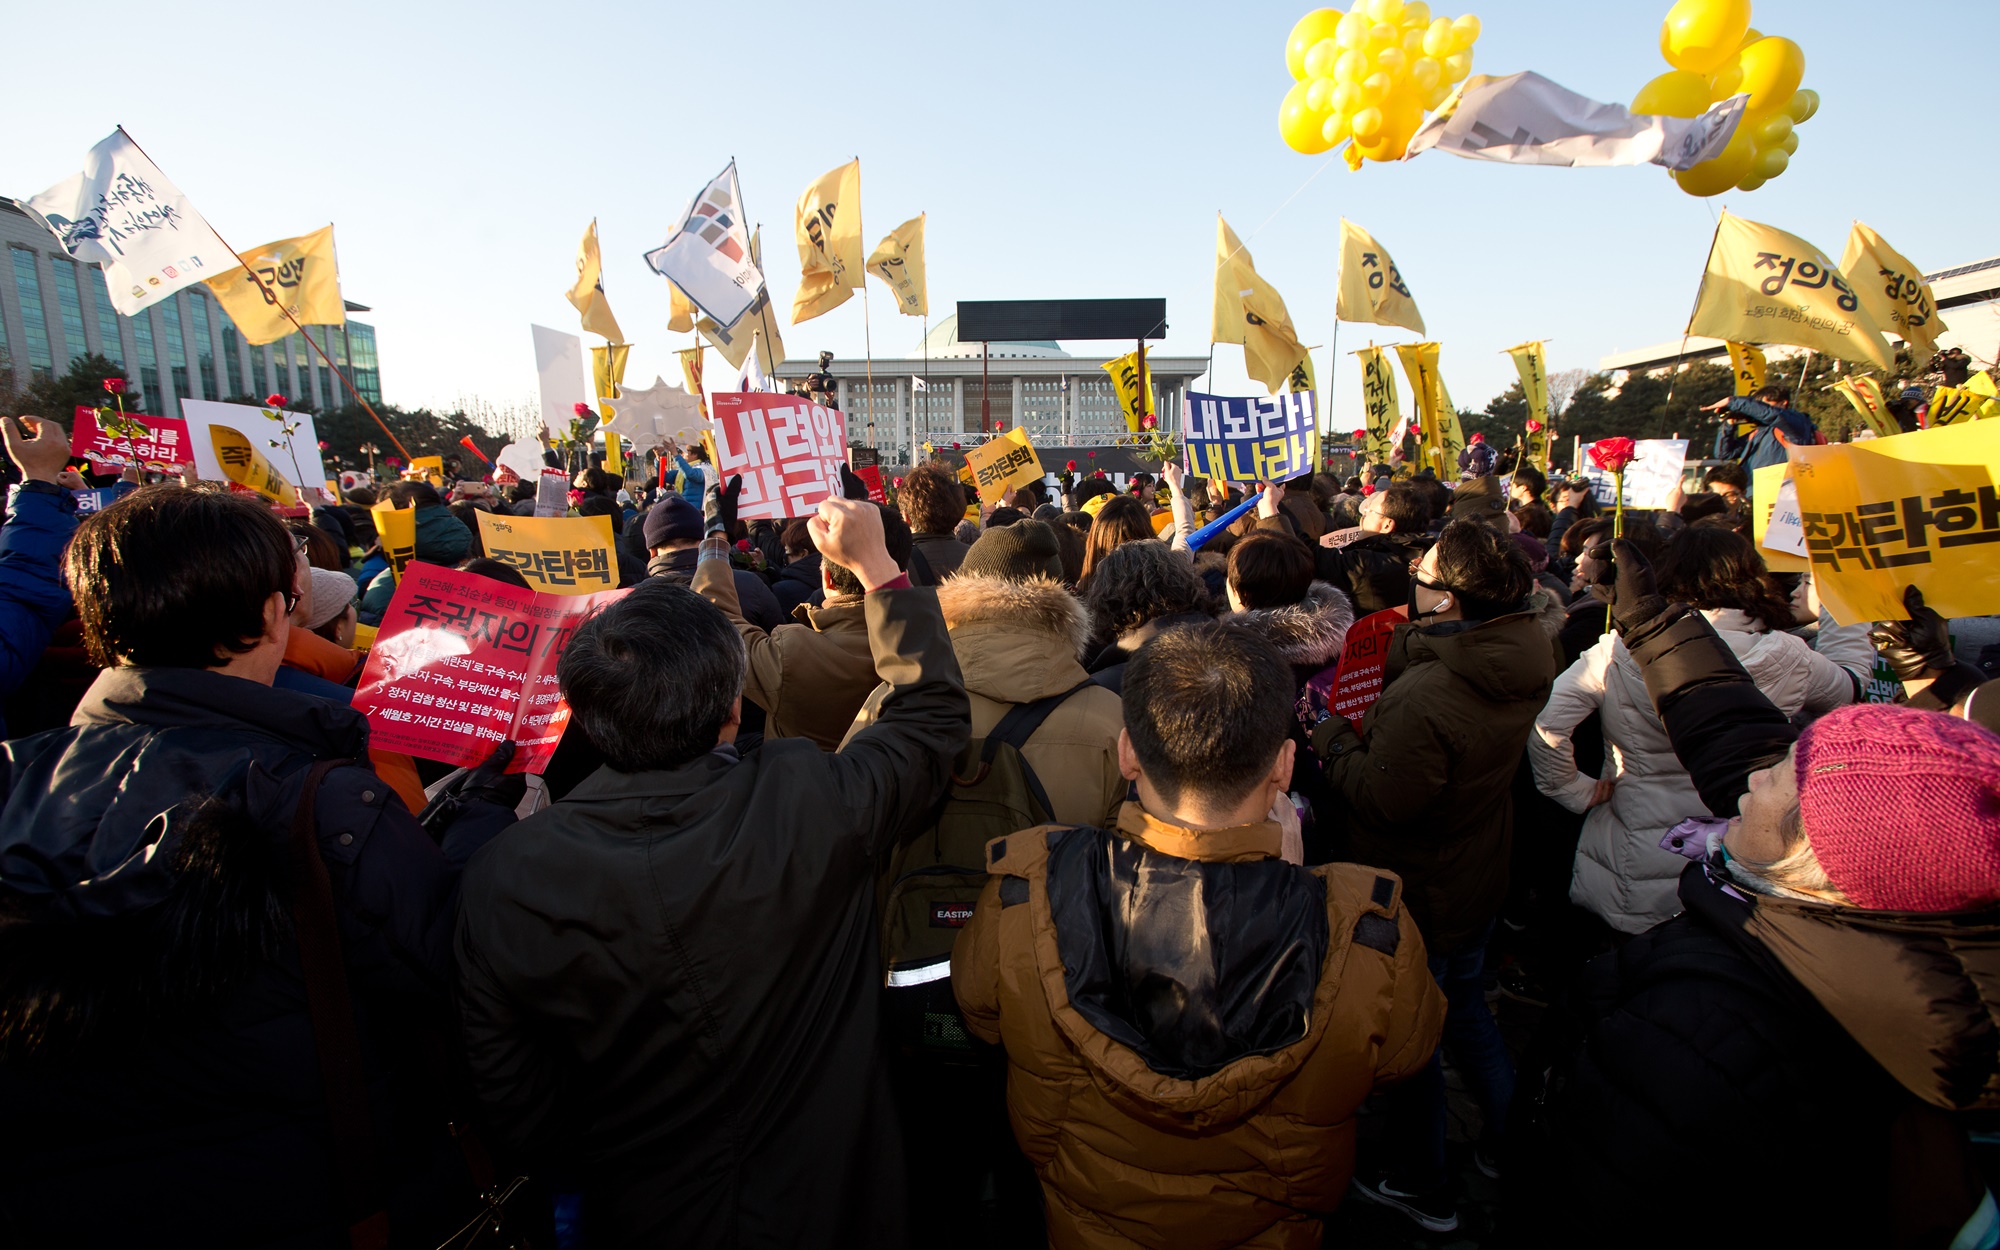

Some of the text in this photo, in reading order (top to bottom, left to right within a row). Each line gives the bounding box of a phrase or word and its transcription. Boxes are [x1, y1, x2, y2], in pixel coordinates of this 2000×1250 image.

[1753, 251, 1859, 312] 정의당
[1743, 305, 1856, 336] 노동의 희망 시민의 꿈
[1186, 390, 1313, 440] 내놔라!
[93, 435, 179, 463] 구속하라
[714, 403, 843, 472] 내려와
[976, 444, 1035, 487] 즉각탄핵
[1187, 430, 1315, 481] 내나라!
[492, 521, 513, 534] 정의당
[1328, 533, 1348, 546] 박근혜
[418, 577, 492, 604] 박근혜-최순실
[495, 596, 517, 611] 등의
[404, 594, 540, 657] 주권자의
[431, 673, 456, 689] 구속,
[456, 678, 500, 697] 부당재산
[500, 688, 521, 703] 몰수
[484, 664, 507, 679] 구속
[507, 669, 527, 684] 수사
[535, 675, 542, 684] 2
[1350, 680, 1372, 693] 부당재산
[375, 682, 514, 725] 5 정치 검찰 청산 및 검찰 개혁
[528, 696, 535, 704] 4
[366, 705, 378, 716] 7
[379, 707, 412, 724] 세월호
[413, 714, 442, 729] 7시간
[442, 718, 475, 736] 진실을
[521, 714, 528, 725] 6
